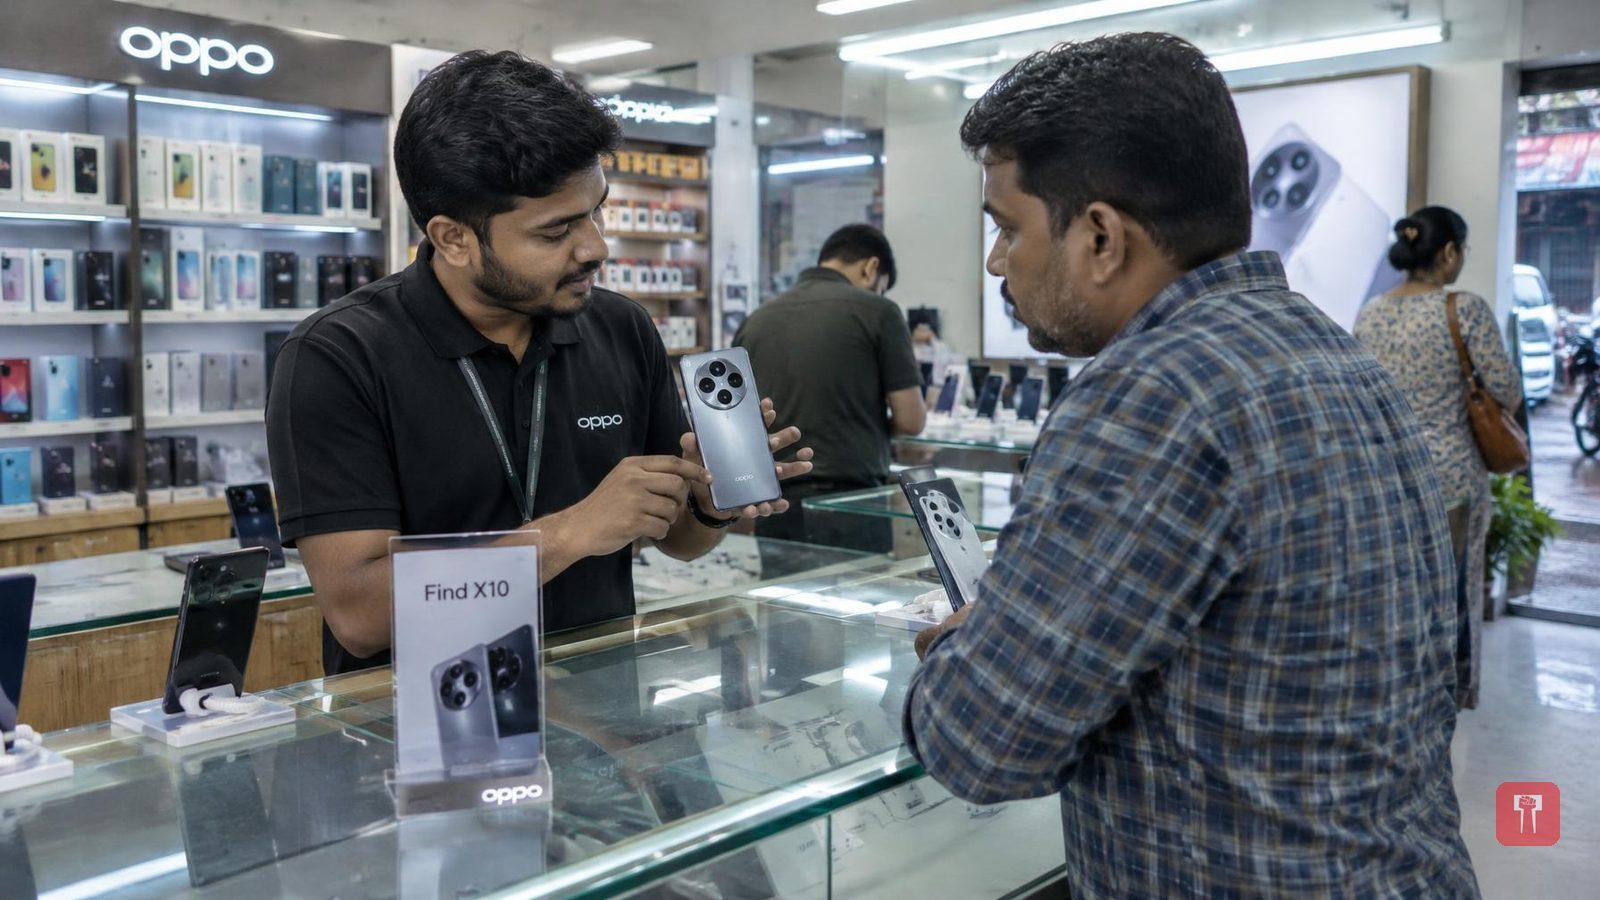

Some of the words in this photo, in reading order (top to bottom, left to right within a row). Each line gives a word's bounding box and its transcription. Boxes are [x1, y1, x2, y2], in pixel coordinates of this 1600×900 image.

[120, 26, 275, 77] oppo
[577, 414, 623, 431] oppo
[425, 582, 468, 601] Find
[473, 580, 509, 599] X10
[481, 784, 543, 806] oppo
